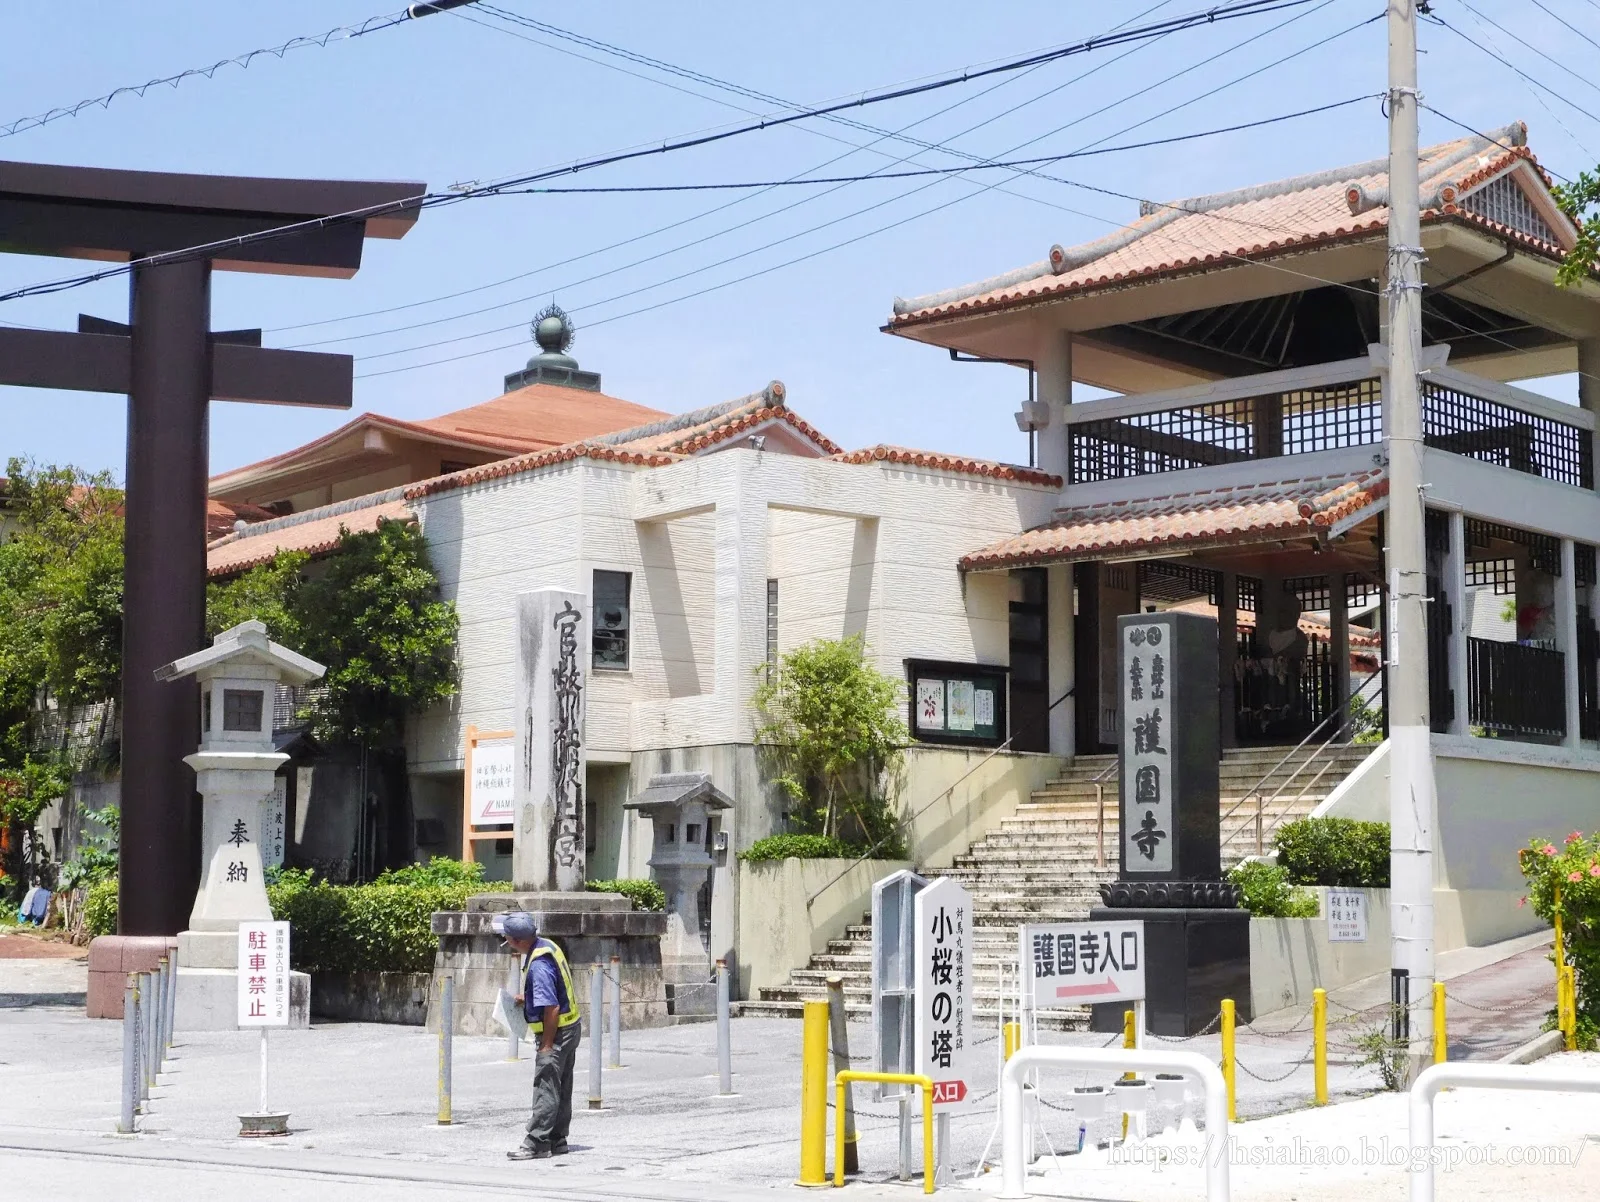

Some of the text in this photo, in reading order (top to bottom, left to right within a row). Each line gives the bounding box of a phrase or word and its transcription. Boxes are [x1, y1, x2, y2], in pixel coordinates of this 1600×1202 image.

[226, 818, 250, 883] 奉納
[248, 931, 267, 1017] 駐車禁止
[1033, 930, 1138, 978] 護国寺入口
[931, 906, 953, 1068] 小桜の塔
[932, 1083, 958, 1102] 入口
